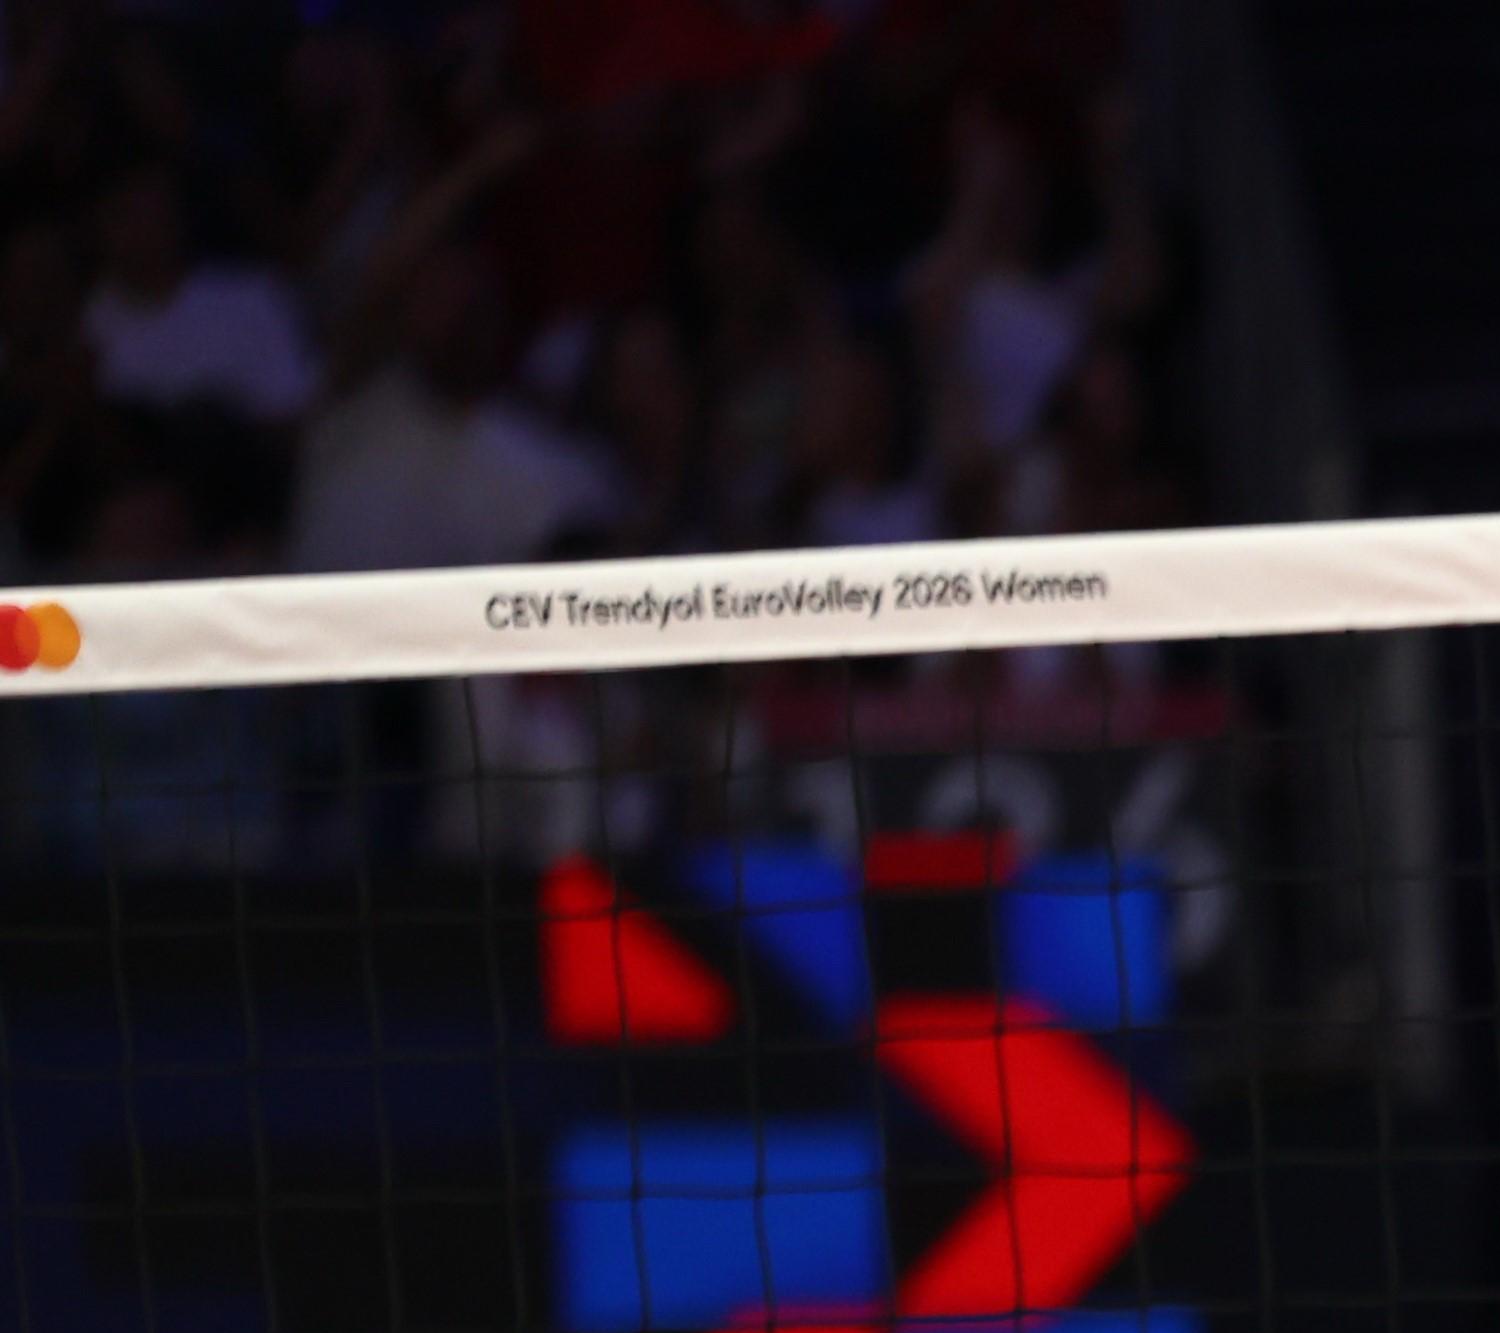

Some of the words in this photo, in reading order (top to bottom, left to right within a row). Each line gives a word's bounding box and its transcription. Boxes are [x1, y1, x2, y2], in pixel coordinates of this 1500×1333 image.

[485, 594, 553, 631] CEV
[562, 584, 702, 630] Trendyol
[712, 577, 884, 620] EuroVolley
[893, 572, 974, 610] 2026
[981, 566, 1109, 604] Women
